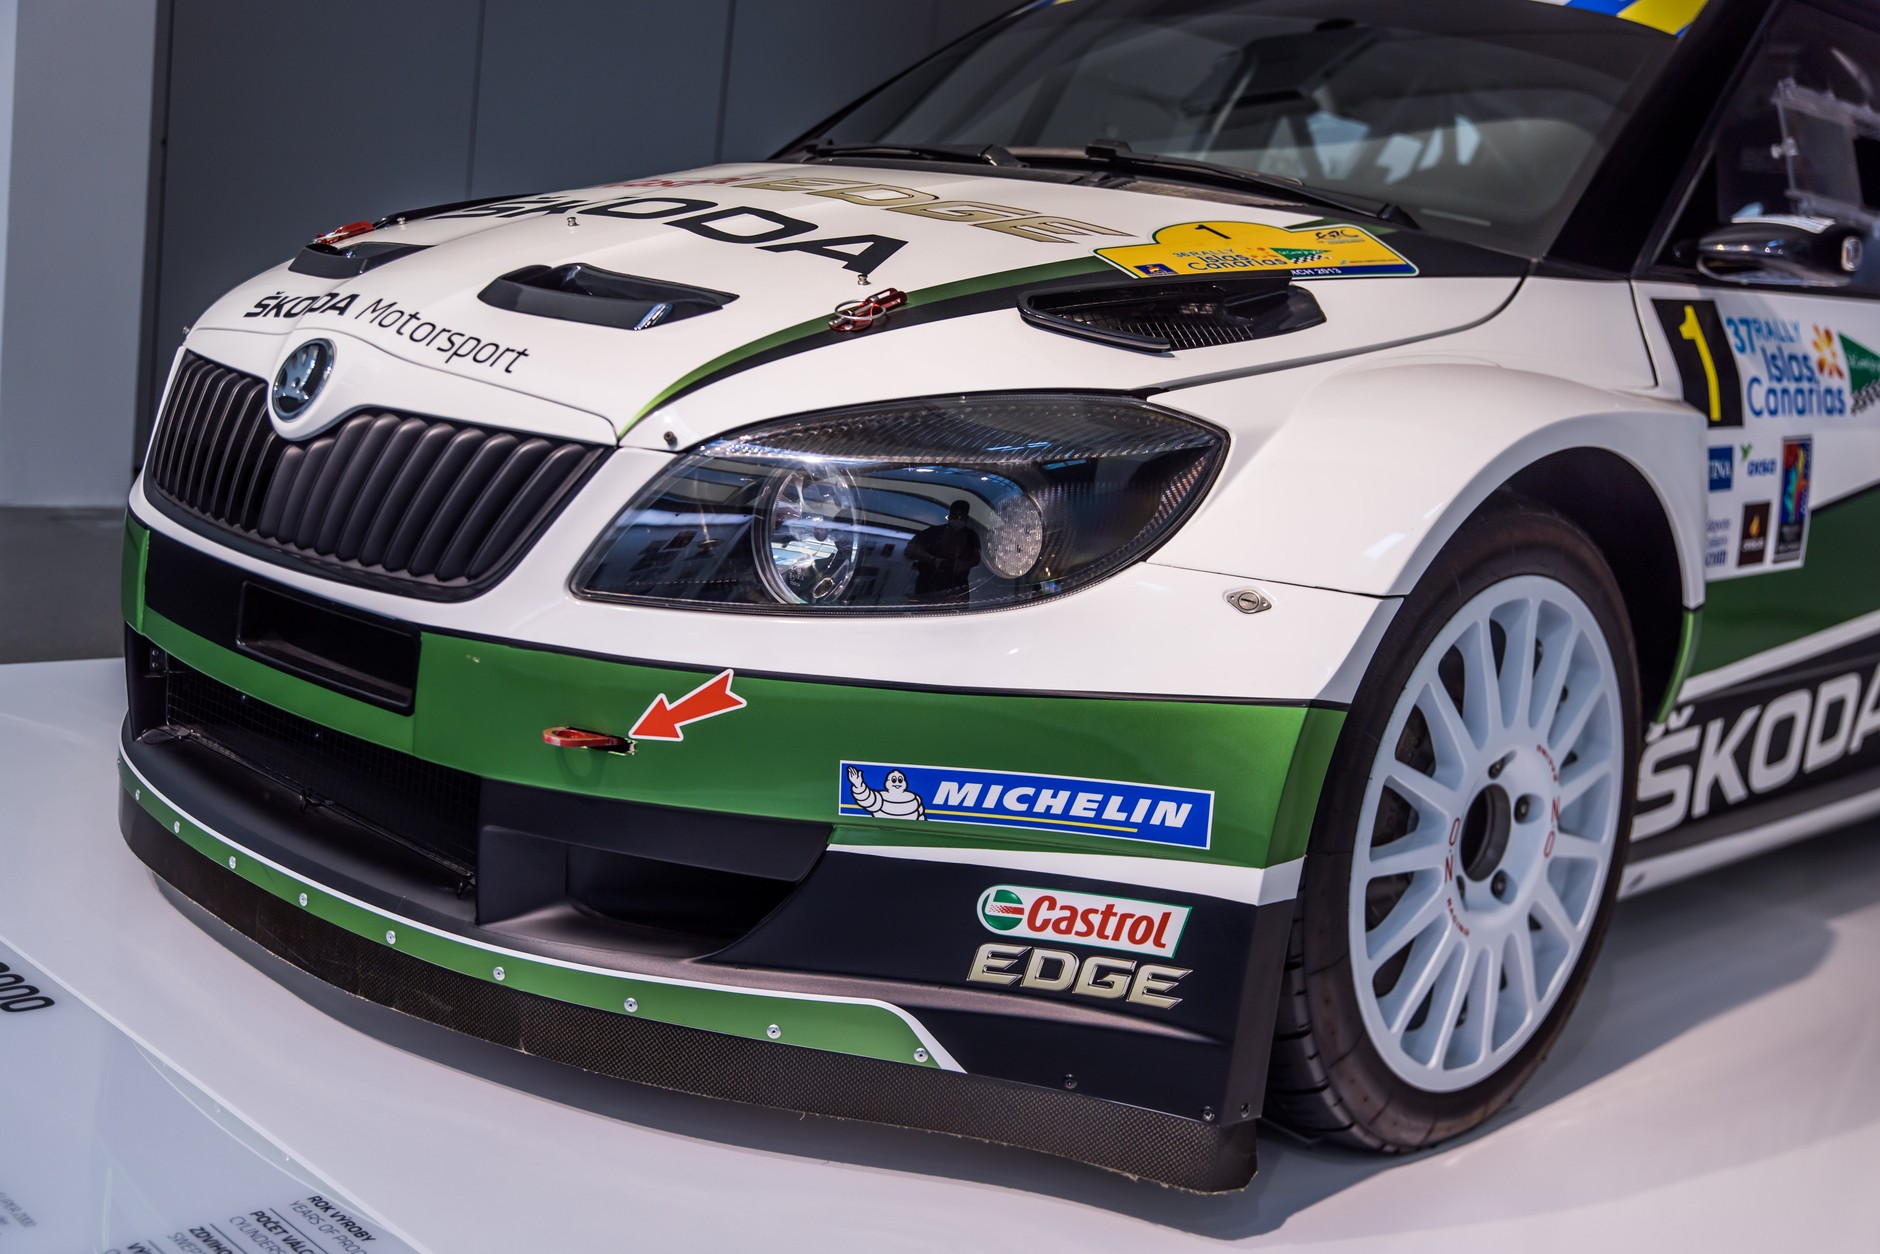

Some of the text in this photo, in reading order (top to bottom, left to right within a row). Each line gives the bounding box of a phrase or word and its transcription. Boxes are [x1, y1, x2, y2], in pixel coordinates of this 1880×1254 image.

[731, 177, 1138, 244] EDGE
[1195, 224, 1232, 240] 1
[428, 195, 908, 276] ŠKODA
[1187, 258, 1288, 271] Canarias
[242, 290, 530, 375] ŠKODA Motorsport
[1678, 305, 1722, 421] 1
[1760, 344, 1818, 384] Islas
[1746, 374, 1847, 419] Canarias
[932, 780, 1193, 829] MICHELIN
[1026, 894, 1173, 949] Castrol
[965, 942, 1194, 1011] EDGE
[248, 1210, 289, 1236] POČET
[289, 1200, 325, 1226] YEARS
[318, 1223, 341, 1235] OF
[307, 1195, 377, 1242] ROK VÝROBY
